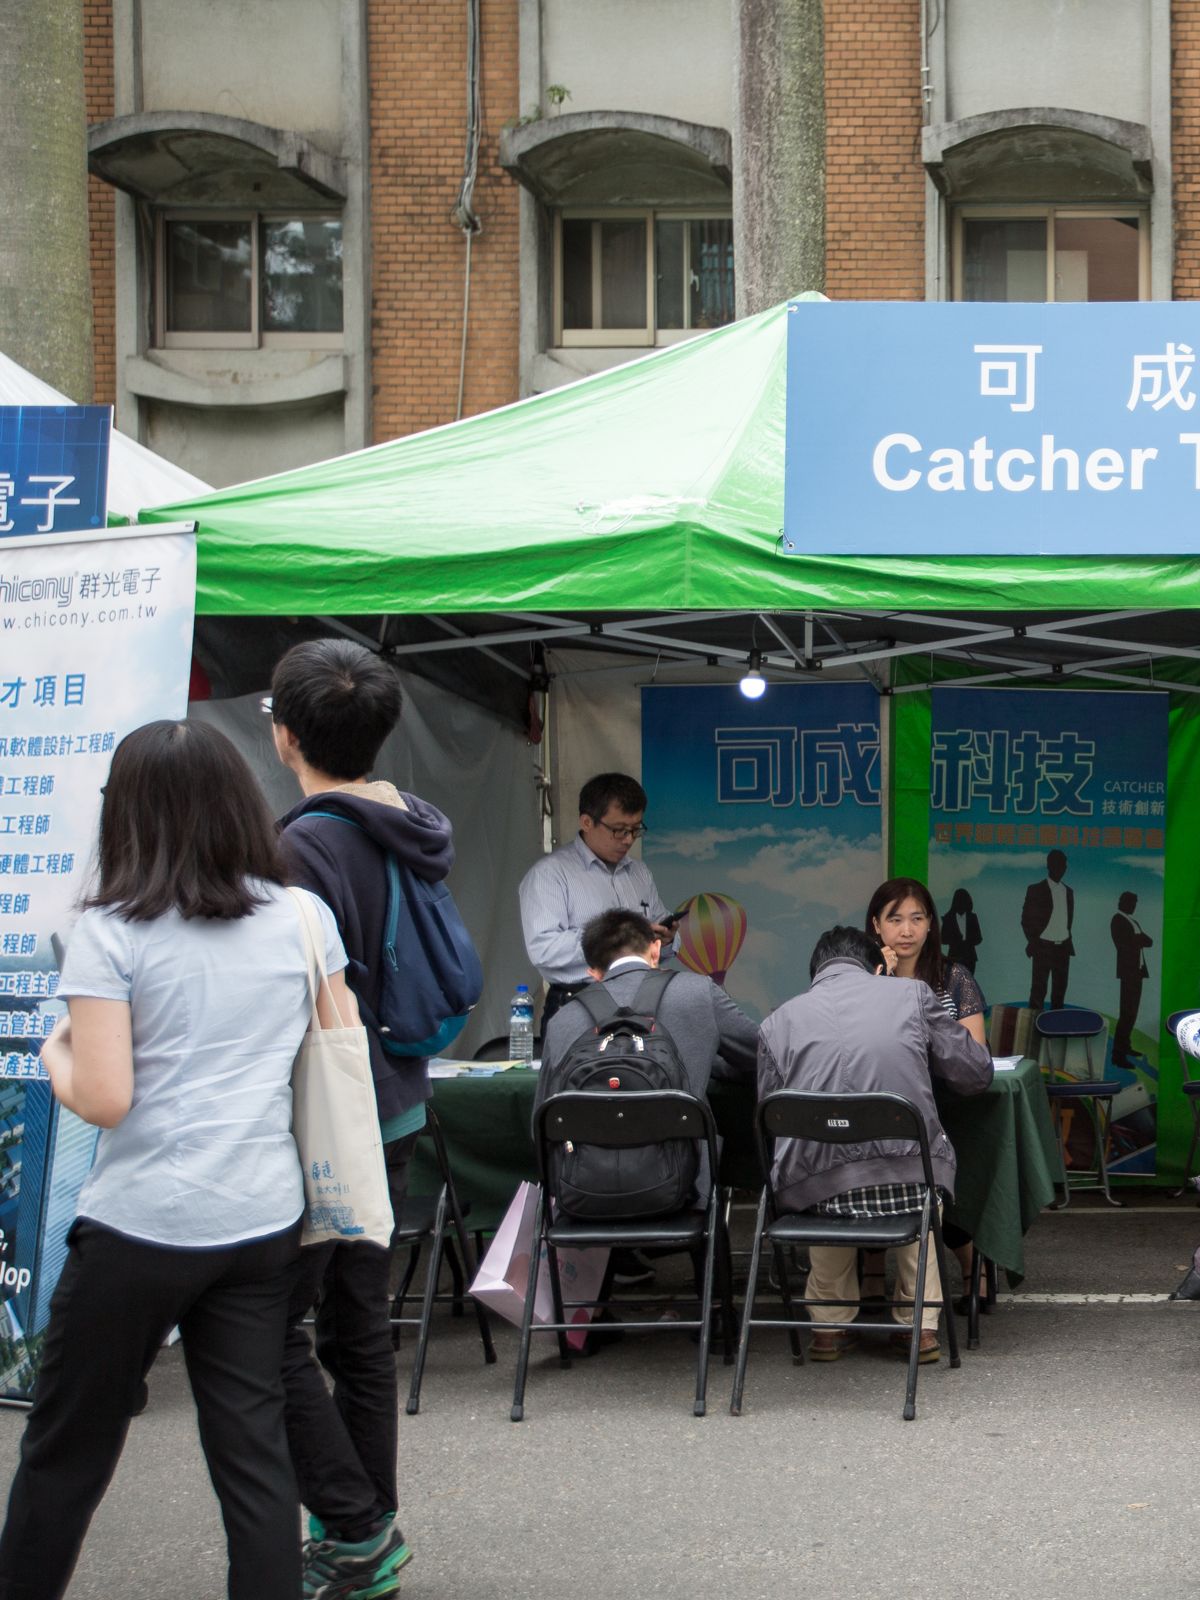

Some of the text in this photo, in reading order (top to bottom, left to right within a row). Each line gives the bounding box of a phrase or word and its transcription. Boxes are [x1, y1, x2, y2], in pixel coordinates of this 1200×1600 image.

[870, 431, 1158, 494] Catcher
[0, 472, 81, 533] 子
[79, 567, 161, 600] 群光電子
[715, 723, 1096, 817] 可成 科技
[0, 775, 55, 796] 工程師
[1103, 780, 1165, 794] CATCHER
[1102, 800, 1165, 817] 技術創新
[0, 933, 37, 955] 程師
